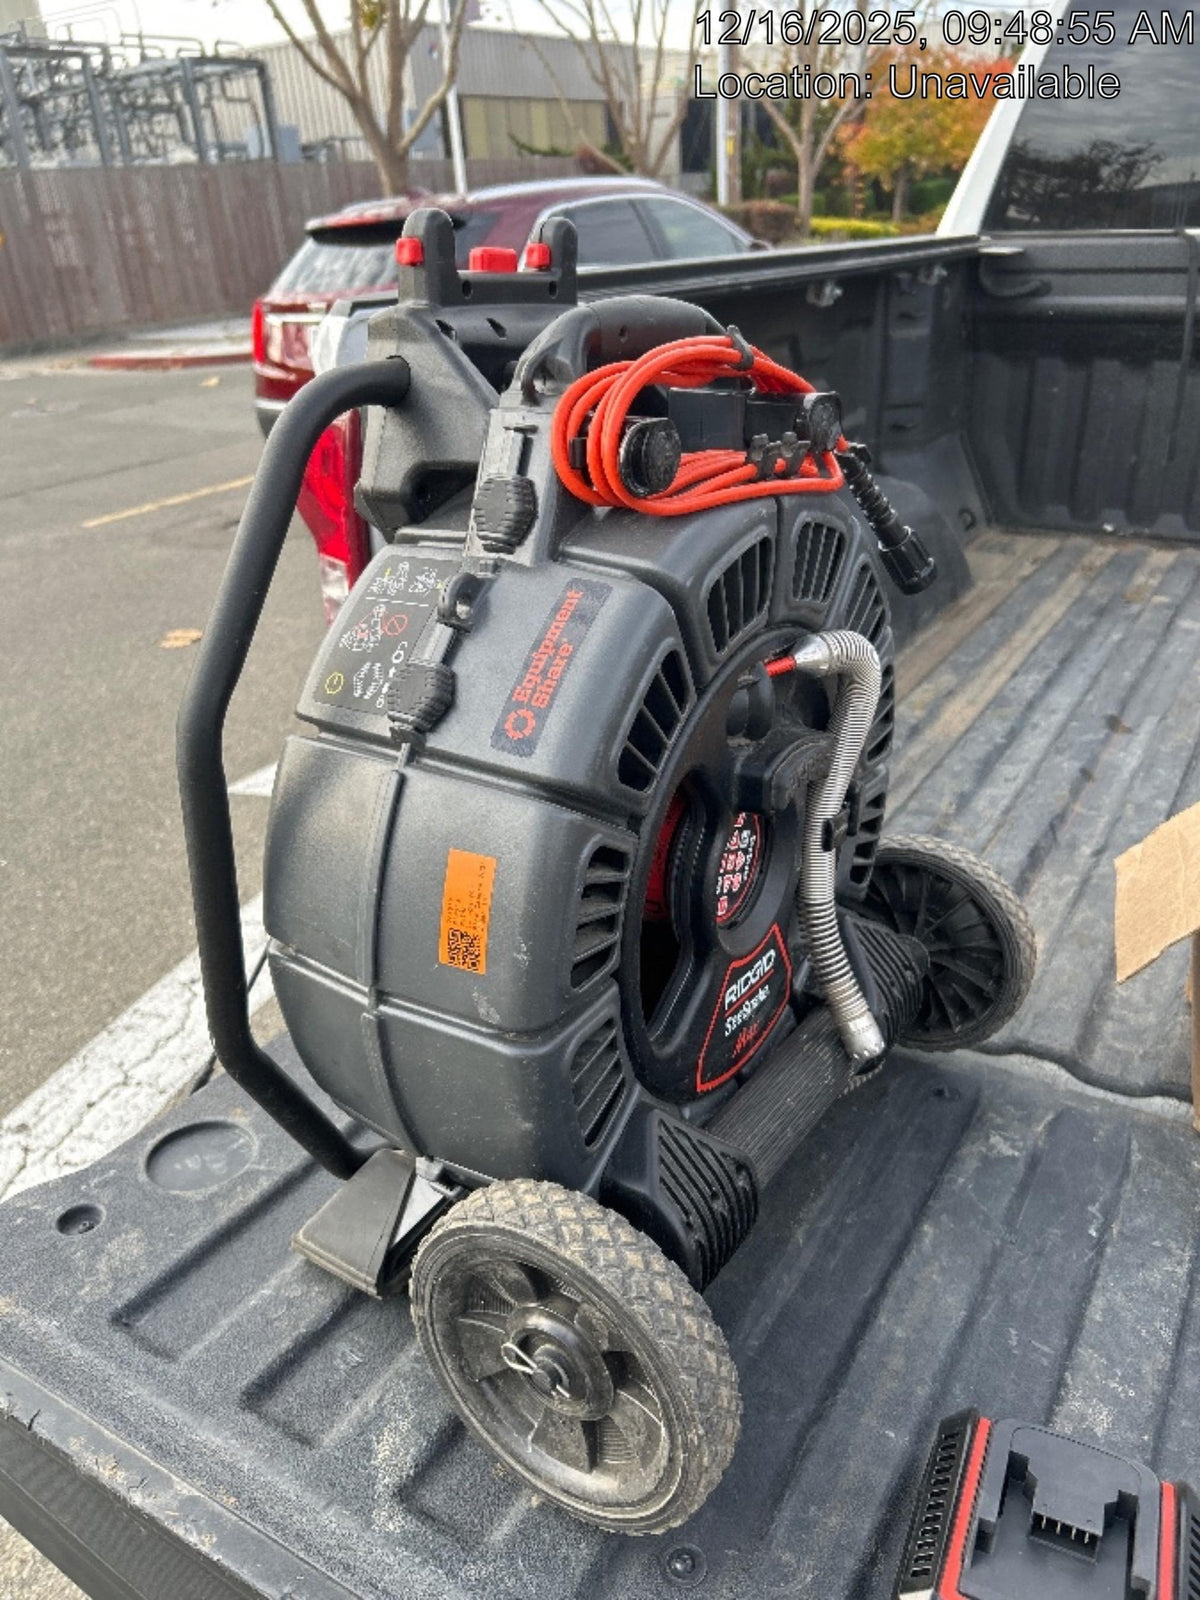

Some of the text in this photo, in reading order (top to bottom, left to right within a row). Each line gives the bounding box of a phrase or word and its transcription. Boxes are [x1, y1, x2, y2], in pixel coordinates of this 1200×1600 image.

[512, 588, 585, 705] Equipment
[531, 642, 574, 709] Share
[725, 948, 776, 1011] RIDGID
